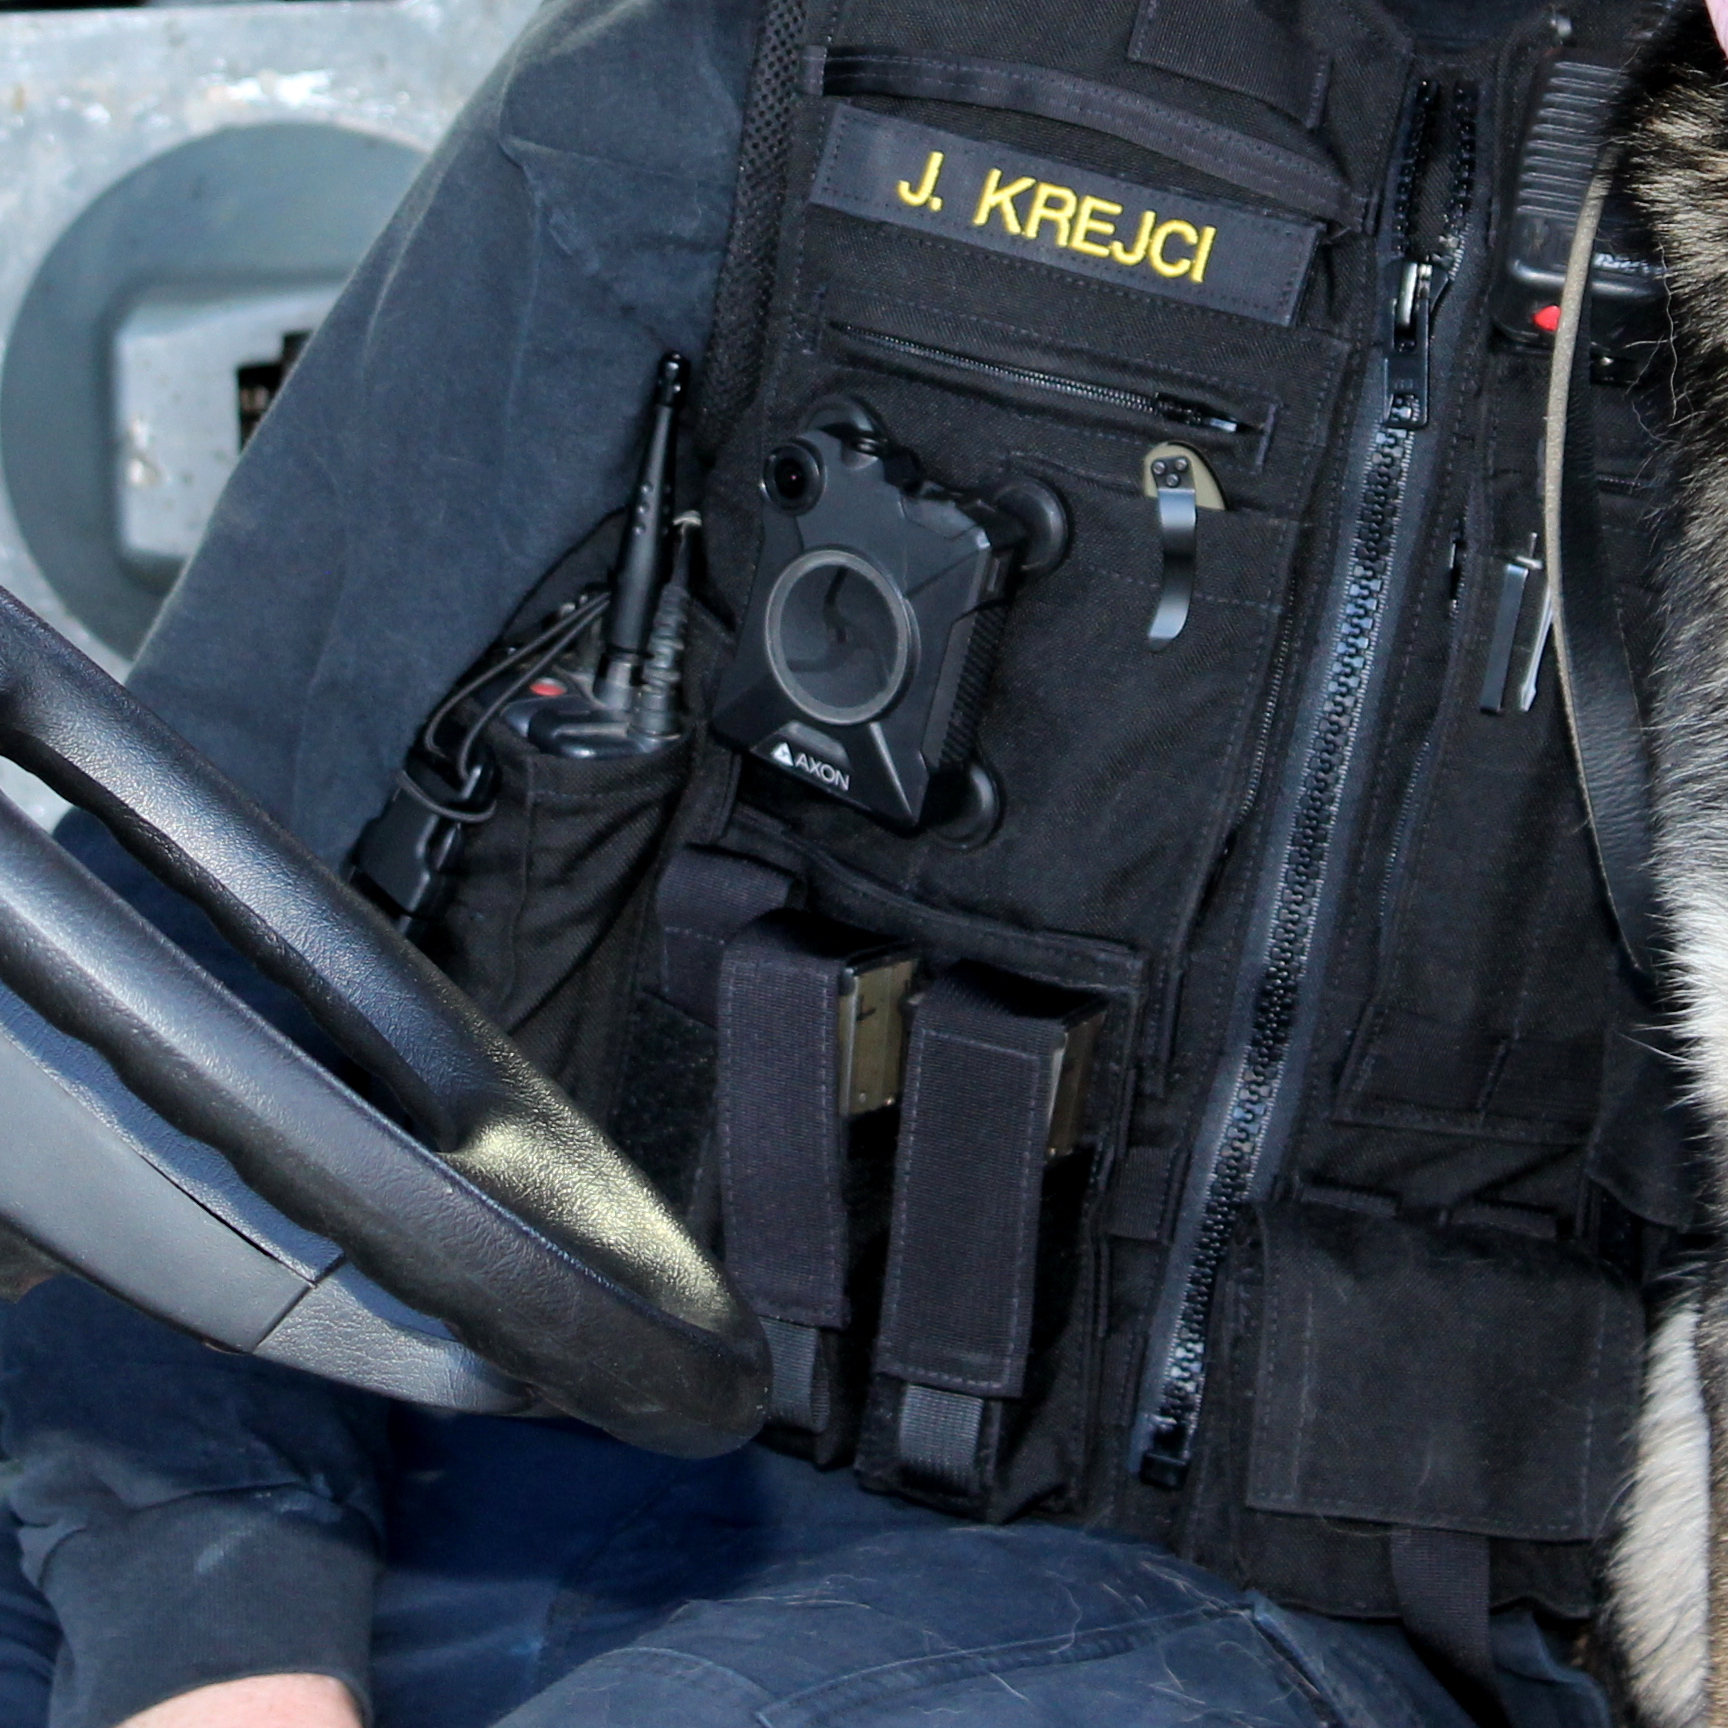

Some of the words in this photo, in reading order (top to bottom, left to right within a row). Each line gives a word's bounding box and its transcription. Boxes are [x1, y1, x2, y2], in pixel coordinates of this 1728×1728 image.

[896, 150, 944, 212] J.
[974, 167, 1217, 283] KREJCI
[794, 752, 850, 792] AXON
